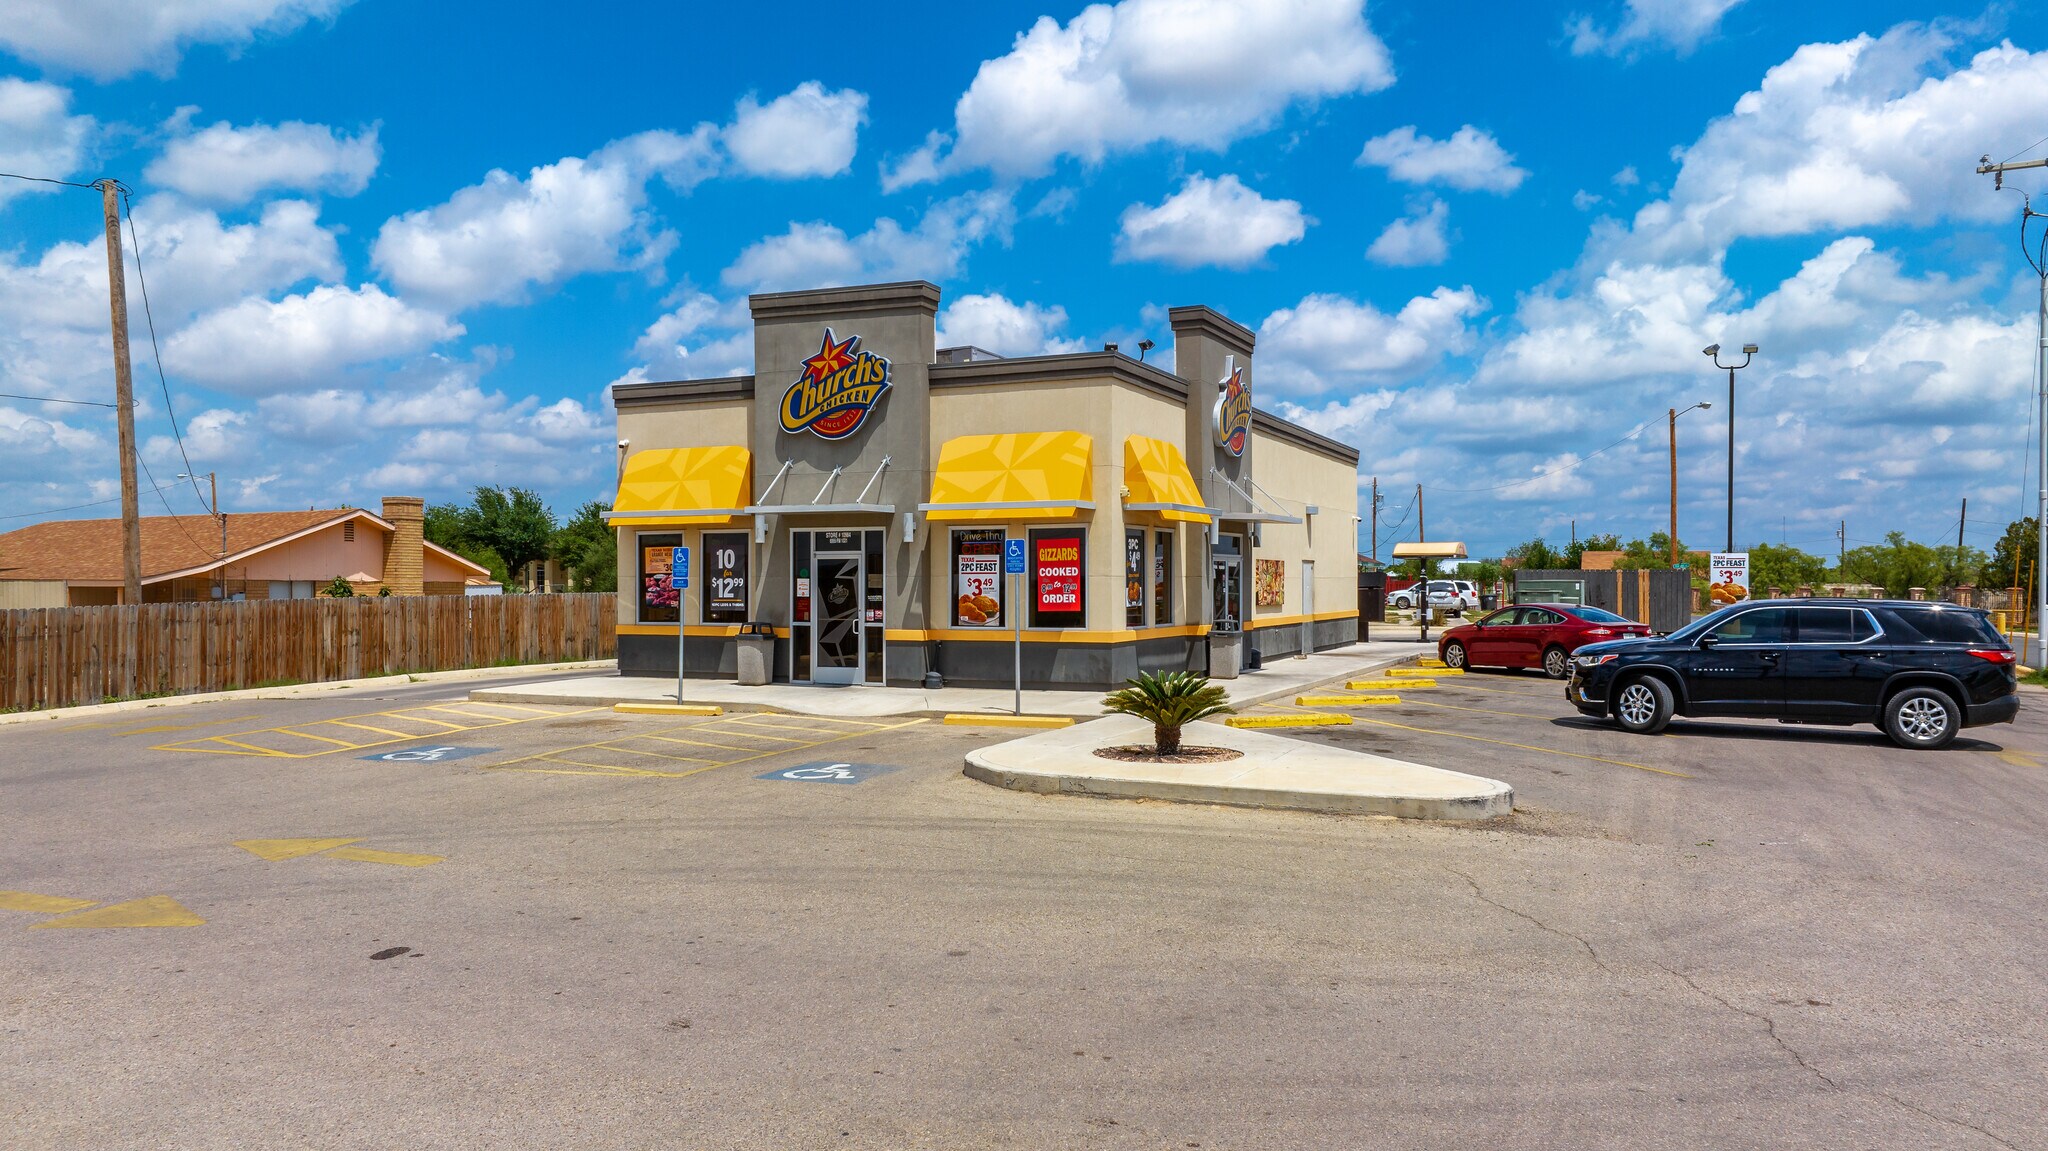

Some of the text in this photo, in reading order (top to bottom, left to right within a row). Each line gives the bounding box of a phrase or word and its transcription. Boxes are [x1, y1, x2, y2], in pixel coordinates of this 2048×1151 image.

[782, 354, 884, 428] Church's
[820, 390, 869, 412] CHICKEN
[820, 420, 840, 428] SINCE
[961, 544, 1003, 554] OPEN
[1128, 539, 1139, 550] 3PC
[716, 549, 735, 569] 10
[1040, 547, 1078, 561] GIZZARDS
[961, 563, 997, 571] 2PC FEAST
[1039, 567, 1079, 577] COOKED
[1042, 594, 1076, 603] ORDER
